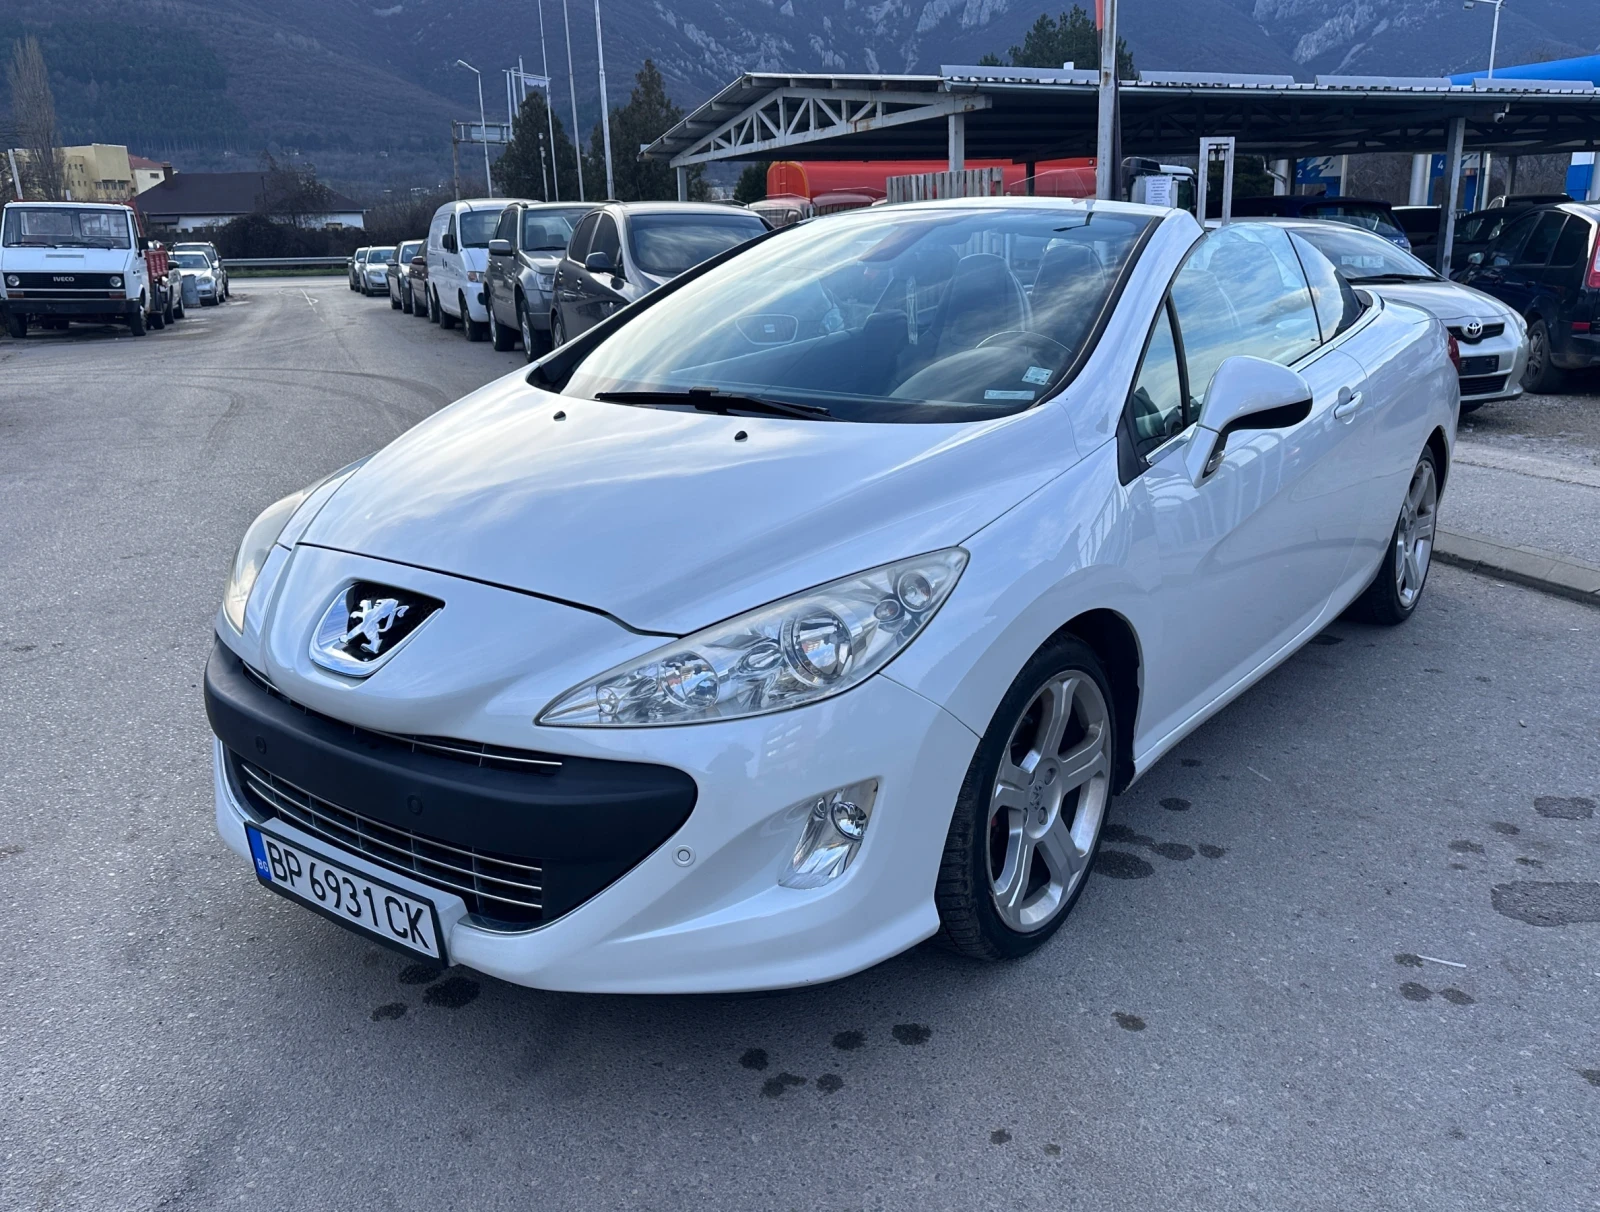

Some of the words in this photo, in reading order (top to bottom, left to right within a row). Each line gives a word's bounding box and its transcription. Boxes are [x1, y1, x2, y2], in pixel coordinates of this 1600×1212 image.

[1437, 160, 1444, 170] 4
[1297, 170, 1303, 178] 2
[257, 858, 269, 873] BG
[266, 840, 302, 887] BP
[310, 862, 379, 928] 6931
[384, 895, 430, 949] CK
